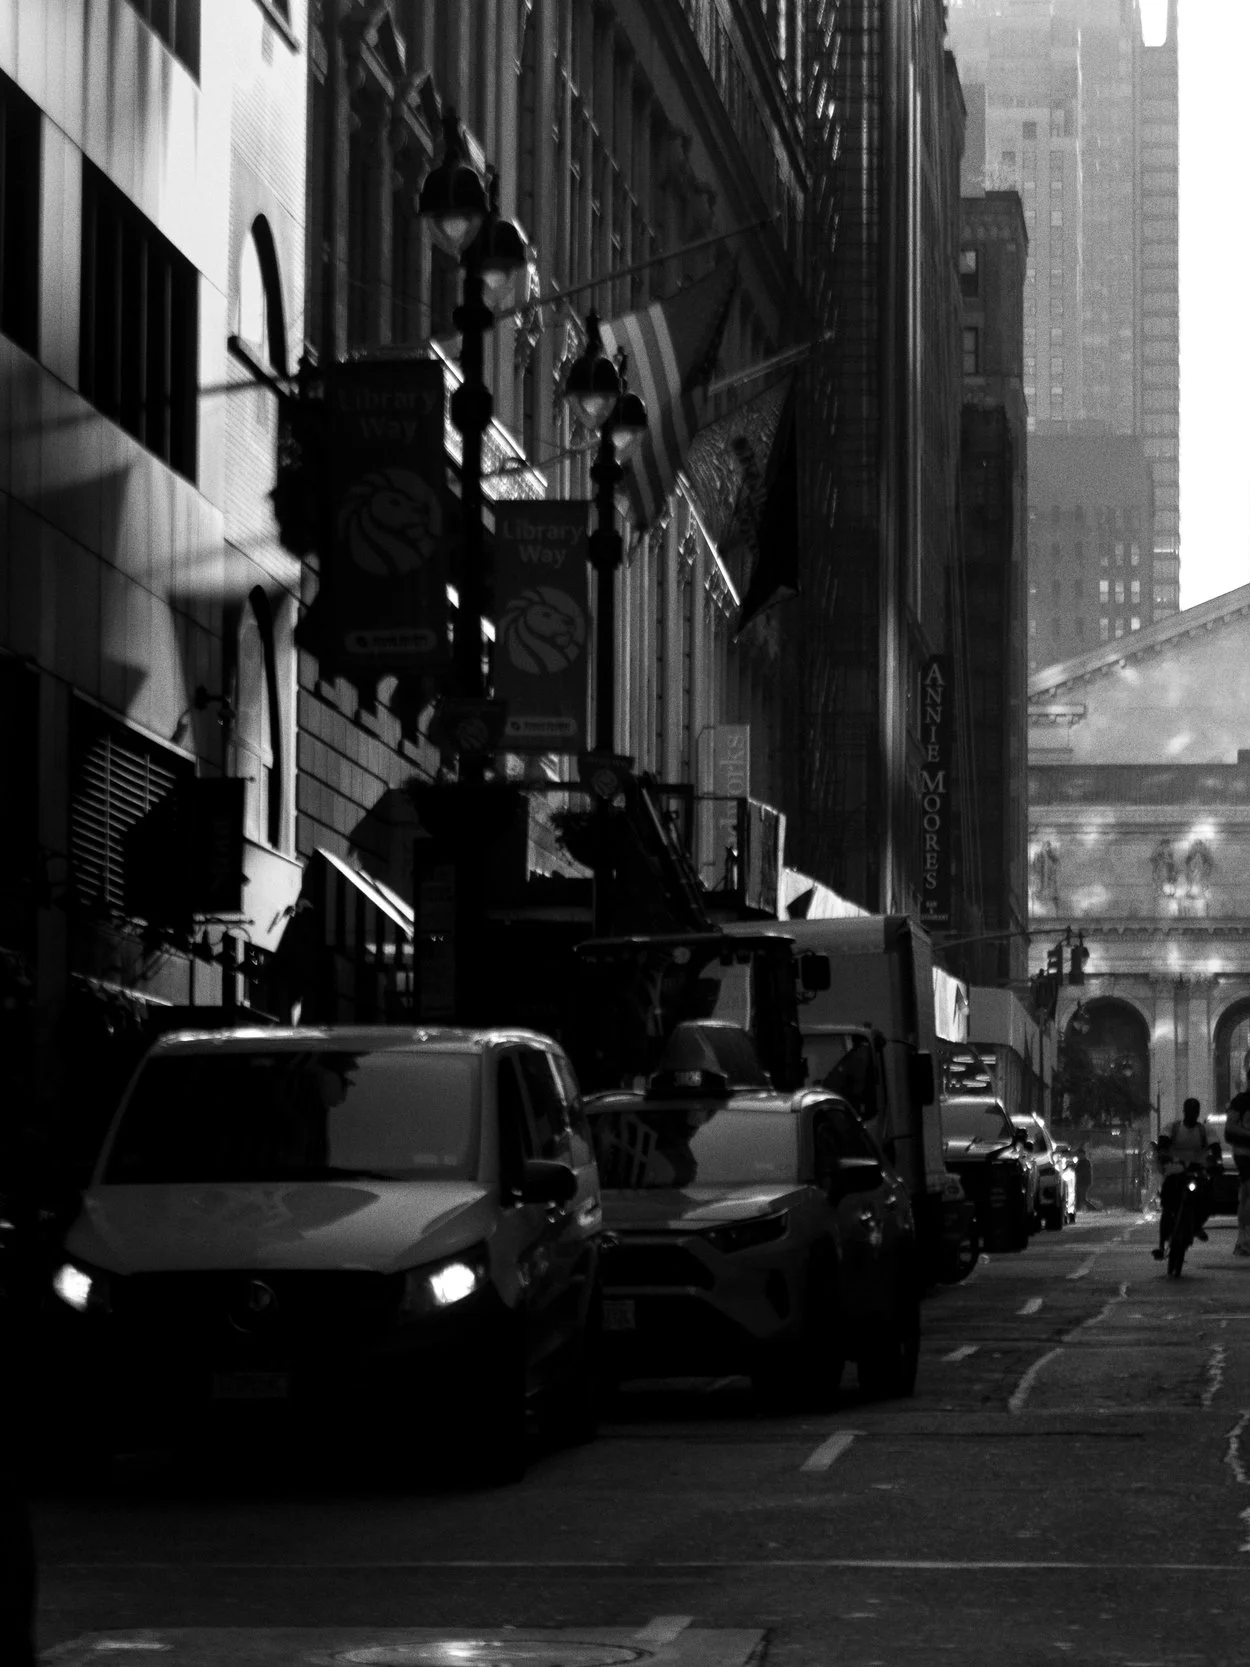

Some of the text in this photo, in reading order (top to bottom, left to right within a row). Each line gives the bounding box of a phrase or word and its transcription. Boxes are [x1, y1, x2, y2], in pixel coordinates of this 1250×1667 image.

[338, 387, 437, 415] Library
[360, 416, 418, 446] Way
[502, 518, 585, 546] Library
[518, 543, 567, 569] Way
[923, 662, 946, 763] ANNIE
[919, 770, 947, 890] MOORES
